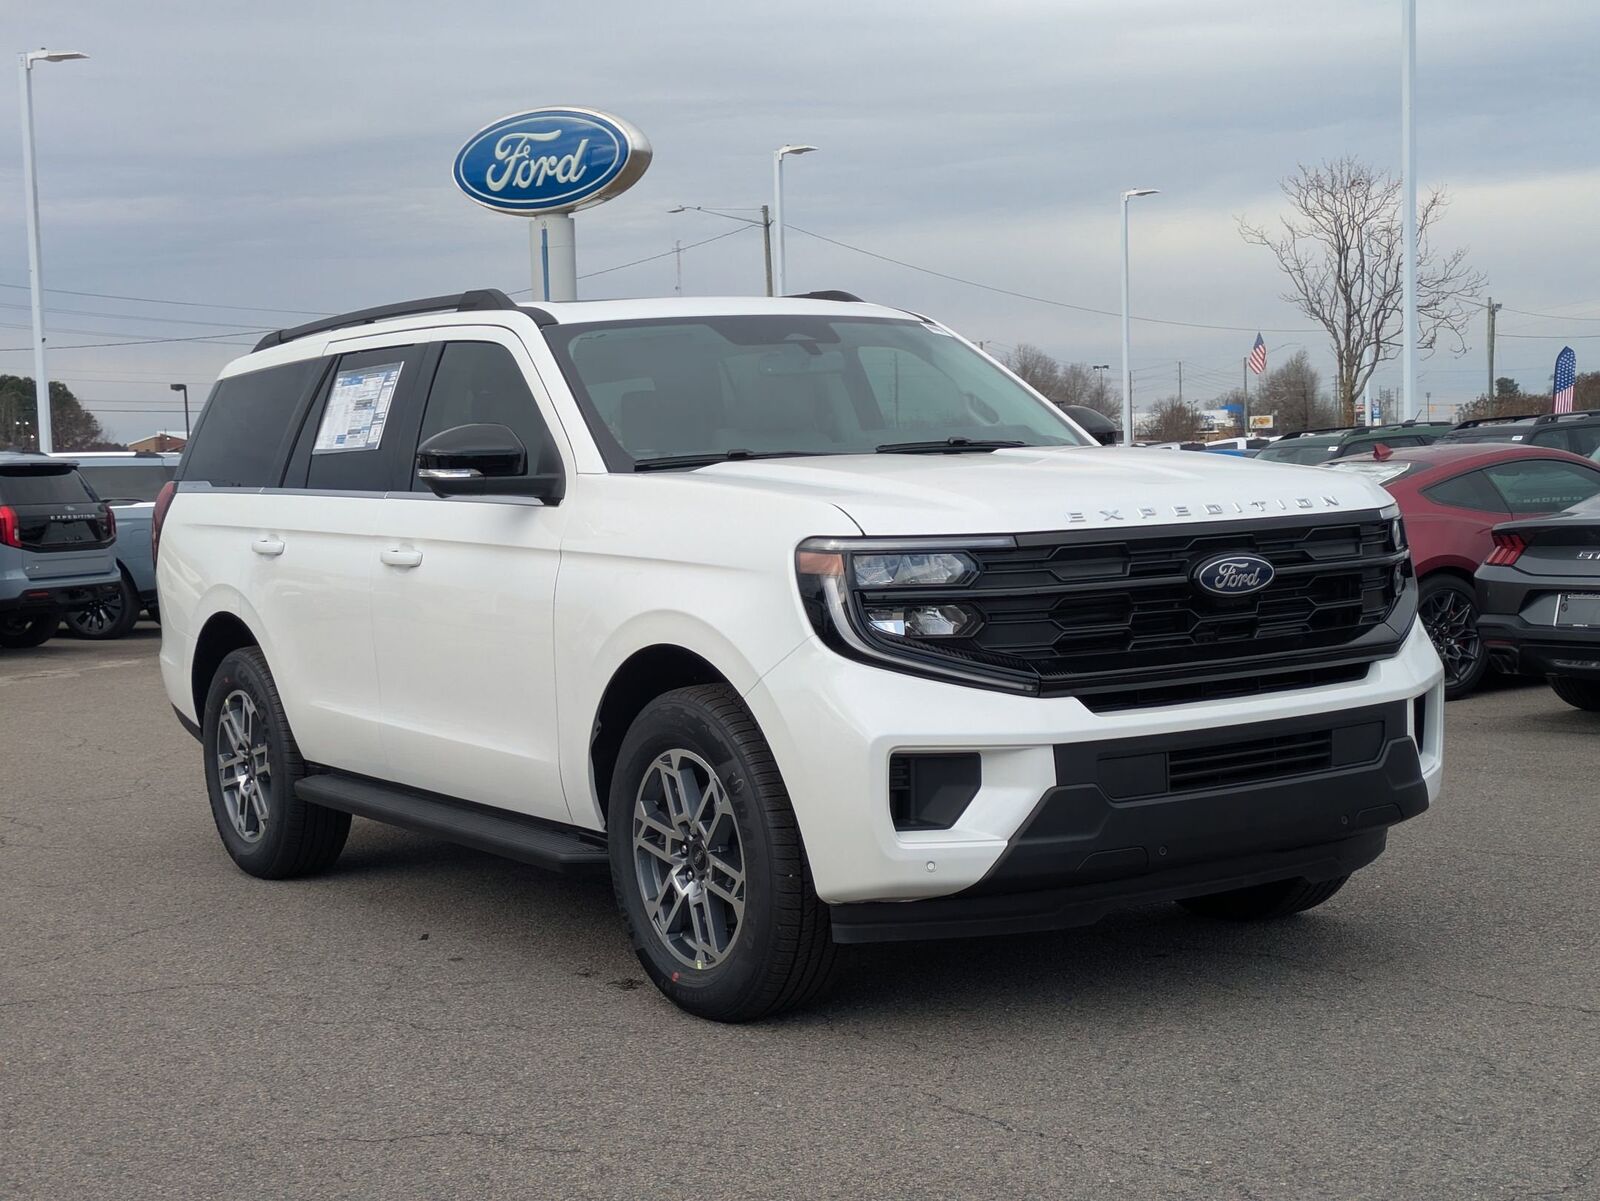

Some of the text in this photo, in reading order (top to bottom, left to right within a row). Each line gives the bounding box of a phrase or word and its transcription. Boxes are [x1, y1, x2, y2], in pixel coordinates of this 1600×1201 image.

[486, 130, 589, 191] Ford
[1066, 496, 1340, 522] EXPEDITION
[1215, 562, 1260, 589] Ford
